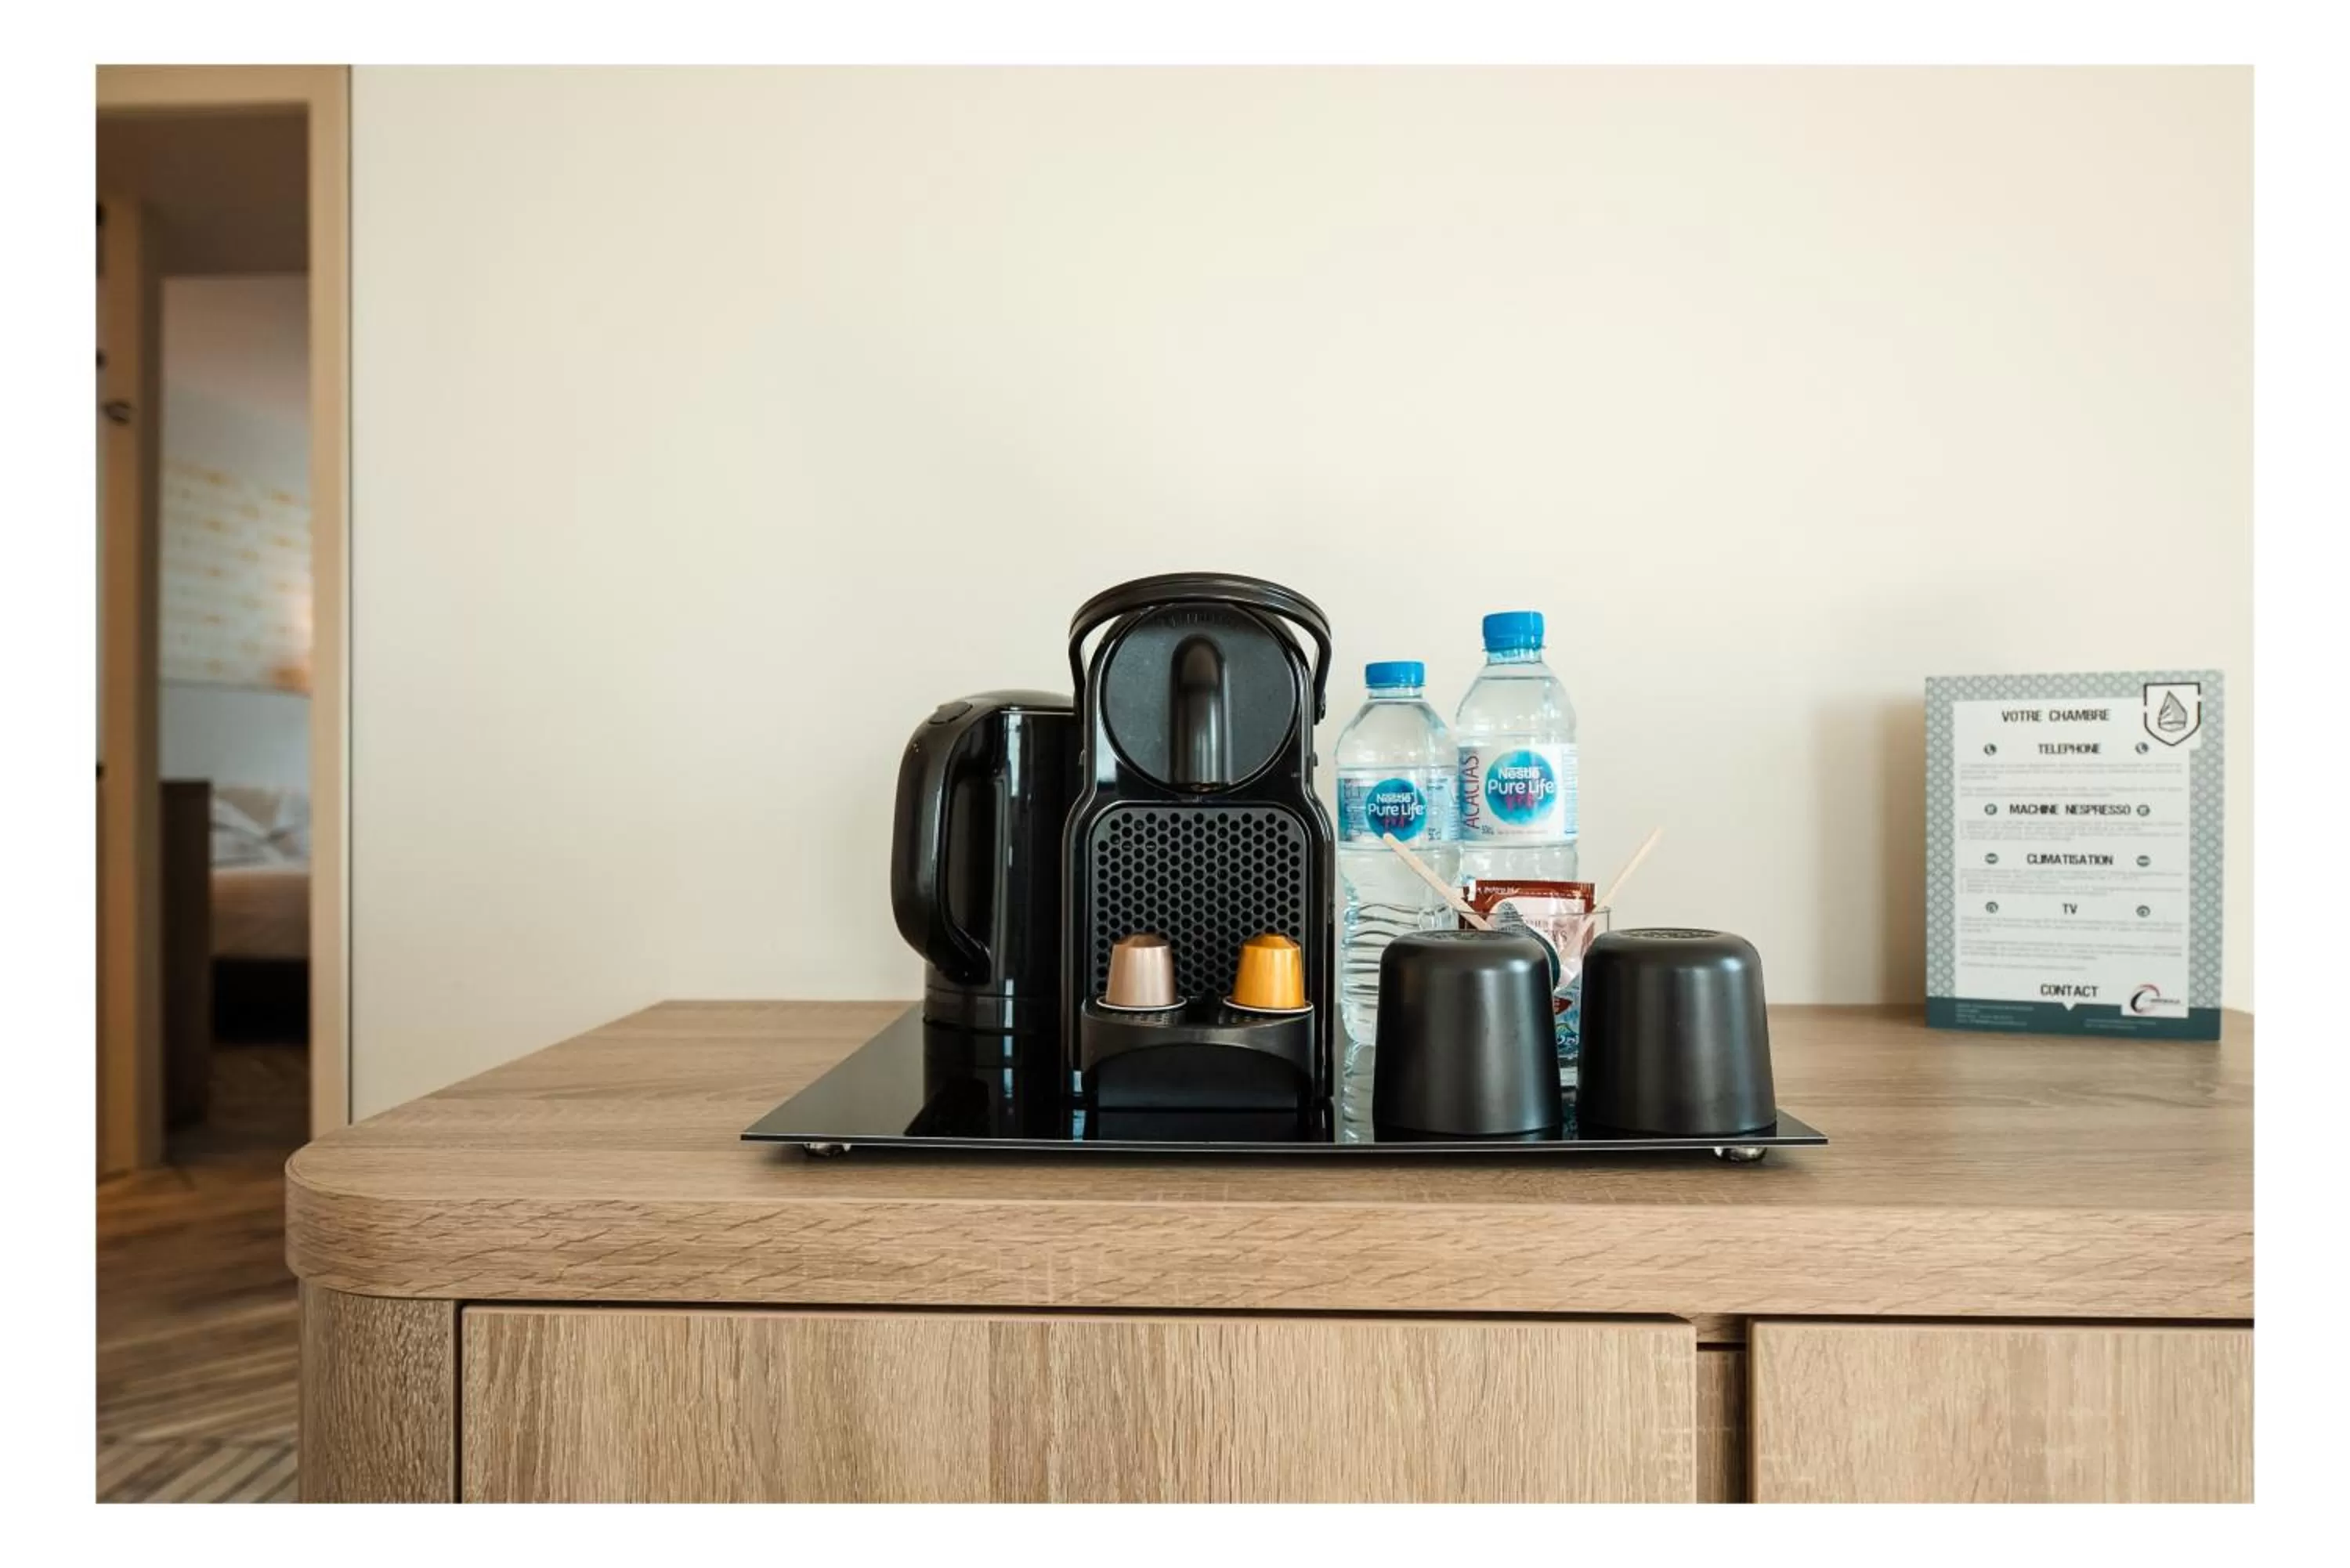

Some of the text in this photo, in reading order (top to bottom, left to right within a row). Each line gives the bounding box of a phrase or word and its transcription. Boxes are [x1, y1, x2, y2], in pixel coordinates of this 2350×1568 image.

[2001, 709, 2111, 722] VOTRE CHAMBRE
[2038, 742, 2101, 754] TELEPHONE
[1462, 755, 1480, 829] ACACIAS
[1488, 779, 1555, 799] Pure Life
[1368, 803, 1424, 820] Pure Life
[2009, 804, 2131, 815] MACHINE NESPRESSO
[2026, 854, 2113, 865] CLIMATISATION
[2063, 903, 2078, 915] TV
[2040, 983, 2099, 997] CONTACT
